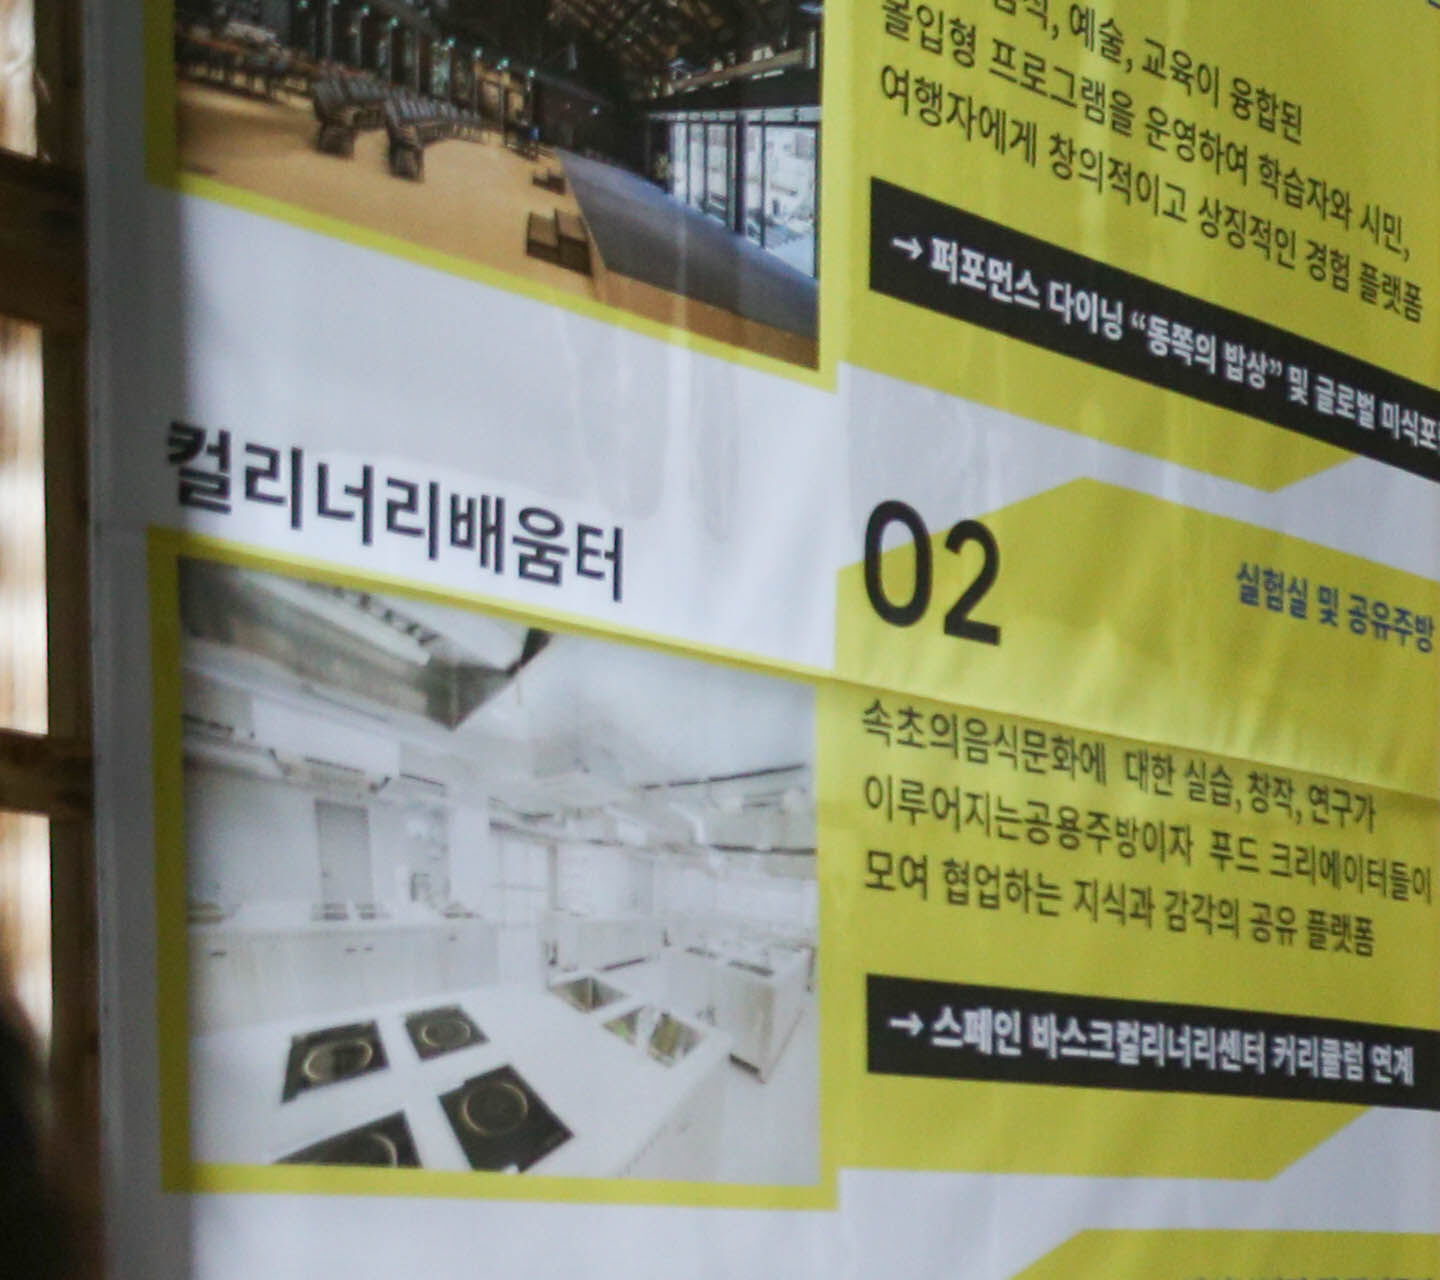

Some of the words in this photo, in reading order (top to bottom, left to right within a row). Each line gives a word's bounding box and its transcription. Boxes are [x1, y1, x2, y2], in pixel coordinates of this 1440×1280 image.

[1069, 3, 1133, 73] 예술,
[1142, 37, 1219, 109] 교육이
[1229, 76, 1302, 145] 융합된
[881, 65, 1037, 168] 여행자에게
[1049, 132, 1188, 223] 창의적이고
[1198, 197, 1297, 271] 상징적인
[1306, 239, 1350, 293] 경험
[1358, 261, 1422, 324] 플랫폼
[988, 38, 1135, 137] 프로그램을
[1145, 106, 1248, 186] 운영하여
[1258, 153, 1352, 231] 학습자와
[1360, 204, 1410, 262] 시민,
[930, 236, 1041, 310] 퍼포먼스
[1048, 280, 1124, 342] 다이닝
[1286, 364, 1309, 405] 및
[1313, 374, 1376, 431] 글로벌
[167, 420, 624, 603] 컬리너리배움터
[863, 499, 1001, 648] 02
[1236, 562, 1308, 620] 실험실
[1317, 584, 1339, 627] 및
[1347, 593, 1435, 653] 공유주방
[862, 699, 1107, 786] 속초의음식문화에
[1125, 751, 1175, 797] 대한
[1184, 759, 1242, 813] 실습,
[1247, 770, 1303, 825] 창작,
[1307, 784, 1376, 834] 연구가
[864, 774, 1194, 867] 이루어지는공용주방이자
[1210, 828, 1260, 873] 푸드
[1269, 841, 1432, 905] 크리에이터들이
[865, 850, 928, 901] 모여
[943, 857, 1062, 917] 협업하는
[1073, 879, 1155, 930] 지식과
[1164, 890, 1239, 940] 감각의
[1250, 901, 1298, 947] 공유
[1306, 908, 1375, 957] 플랫폼
[930, 1005, 1022, 1058] 스페인
[1029, 1011, 1266, 1074] 바스크컬리너리센터
[1272, 1034, 1364, 1080] 커리큘럼
[1369, 1043, 1415, 1087] 연계
